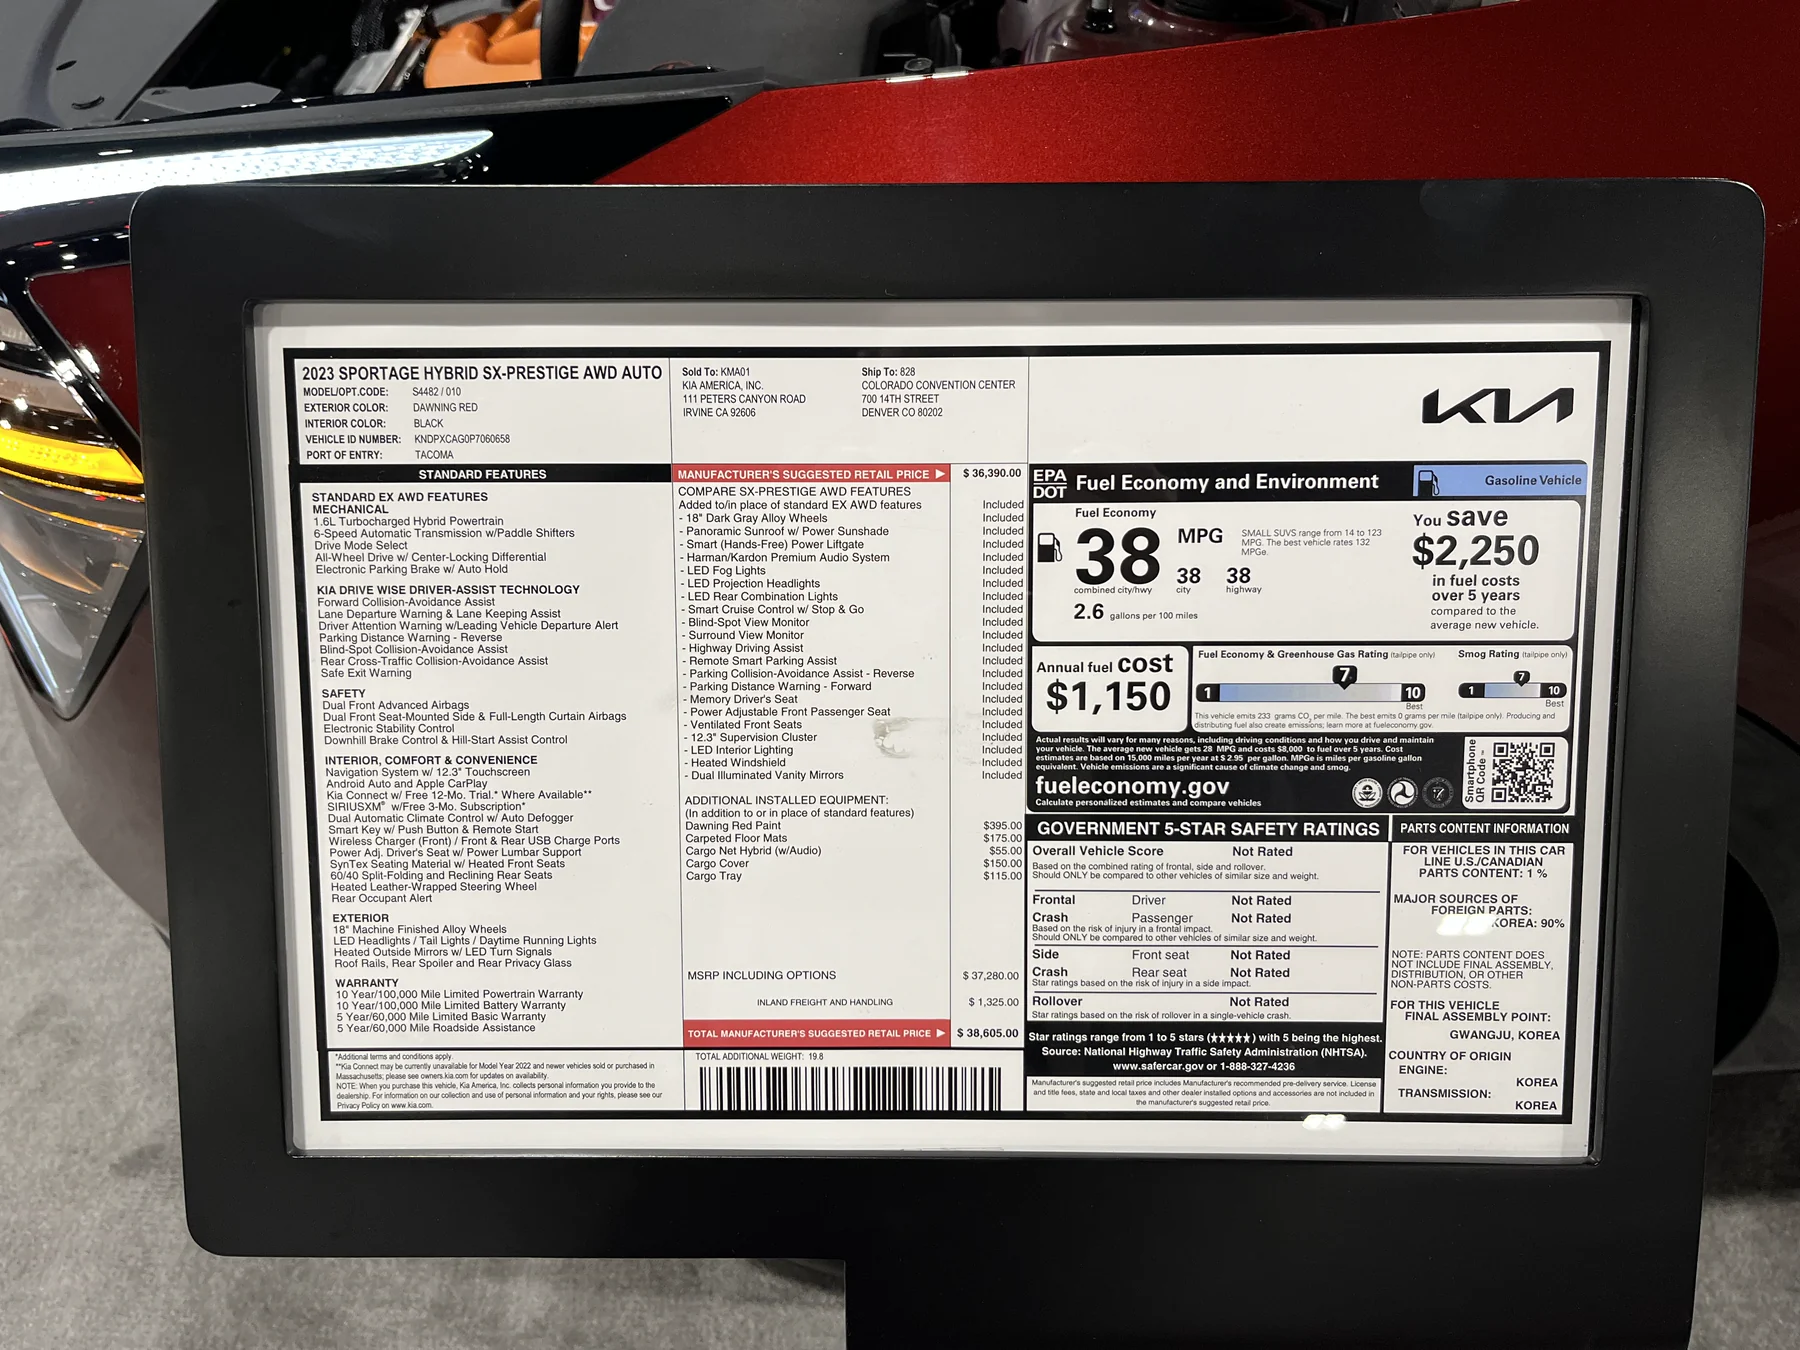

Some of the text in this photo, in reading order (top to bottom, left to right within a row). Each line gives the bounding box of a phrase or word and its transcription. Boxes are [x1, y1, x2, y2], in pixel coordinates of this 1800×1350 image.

[302, 365, 662, 381] 2023 SPORTAGE HYBRID SX-PRESTIGE AWD AUTO
[682, 366, 750, 377] Sold To: KMA01
[861, 366, 916, 379] Ship To: 828
[303, 387, 389, 397] MODEL/OPT.CODE:
[412, 386, 439, 397] S4482
[445, 386, 462, 397] 010
[682, 380, 764, 391] KIA AMERICA, INC.
[304, 402, 478, 413] EXTERIOR COLOR: DAWNING RED
[1422, 387, 1575, 424] KIA
[862, 407, 943, 417] DENVER CO 80202
[305, 434, 345, 444] VEHICLE
[347, 434, 357, 444] ID
[358, 434, 402, 444] NUMBER:
[306, 449, 454, 460] PORT OF ENTRY: TACOMA
[419, 469, 547, 480] STANDARD FEATURES
[678, 469, 930, 480] MANUFACTURER'S SUGGESTED RETAIL PRICE
[963, 468, 1022, 479] $ 36,390.00
[1033, 469, 1067, 482] EPA
[1076, 473, 1379, 494] Fuel Economy and Environment
[1485, 474, 1582, 486] Gasoline Vehicle
[1033, 486, 1068, 499] DOT
[312, 504, 389, 514] MECHANICAL
[1075, 507, 1157, 519] Fuel Economy
[313, 516, 504, 529] 1.6L Turbocharged Hybrid Powertrain
[1413, 510, 1508, 527] You save
[1178, 527, 1223, 544] MPG
[1076, 527, 1160, 585] 38
[1412, 532, 1539, 570] $2,250
[1176, 567, 1201, 584] 38
[1226, 567, 1251, 584] 38
[317, 584, 580, 595] KIA DRIVE WISE DRIVER-ASSIST TECHNOLOGY
[1175, 585, 1192, 595] city
[1226, 585, 1263, 595] highway
[1458, 649, 1486, 660] Smog
[1488, 649, 1520, 660] Rating
[1036, 653, 1174, 673] Annual fuel cost
[321, 688, 366, 699] SAFETY
[1046, 678, 1171, 715] $1,150
[323, 723, 455, 736] Electronic Stability Control
[1464, 739, 1477, 803] Smartphone
[326, 778, 488, 791] Android Auto and Apple CarPlay
[1475, 758, 1486, 803] QR Code
[1035, 775, 1230, 799] fueleconomy.gov
[685, 820, 781, 833] Dawning Red Paint
[983, 820, 1023, 831] $395.00
[1037, 821, 1380, 836] GOVERNMENT 5-STAR SAFETY RATINGS
[1400, 822, 1569, 834] PARTS CONTENT INFORMATION
[1032, 845, 1293, 857] Overall Vehicle Score Not Rated
[686, 871, 742, 883] Cargo Tray
[983, 870, 1023, 881] $115.00
[332, 913, 389, 923] EXTERIOR
[335, 978, 399, 988] WARRANTY
[1032, 995, 1289, 1007] Rollover Not Rated
[337, 1023, 536, 1034] 5 Year/60,000 Mile Roadside Assistance
[687, 1029, 931, 1038] TOTAL MANUFACTURER'S SUGGESTED RETAIL PRICE
[957, 1027, 1019, 1039] $ 38,605.00
[1449, 1029, 1561, 1041] GWANGJU, KOREA
[401, 1052, 434, 1060] conditions
[695, 1052, 824, 1061] TOTAL ADDITIONAL WEIGHT: 19.8
[1112, 1061, 1204, 1073] www.safercar.gov
[1220, 1062, 1296, 1071] 1-888-327-4236
[1399, 1065, 1447, 1075] ENGINE:
[1397, 1088, 1491, 1099] TRANSMISSION:
[336, 1101, 361, 1111] Privacy
[361, 1101, 381, 1110] Policy
[1515, 1100, 1557, 1110] KOREA
